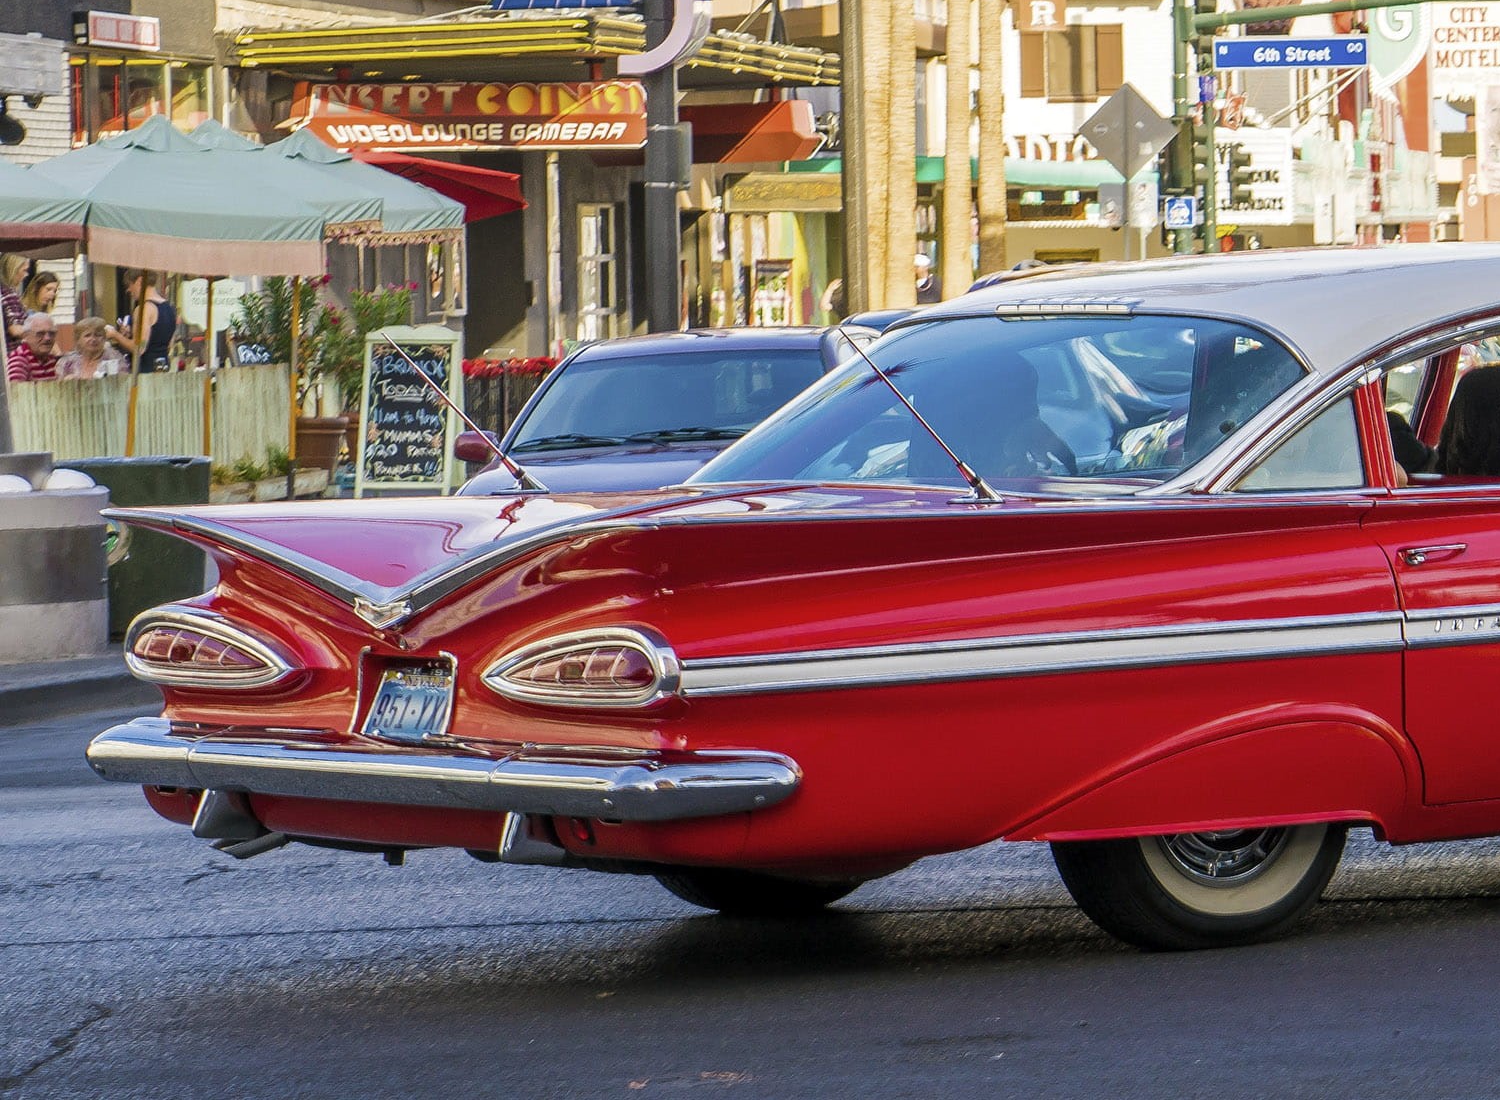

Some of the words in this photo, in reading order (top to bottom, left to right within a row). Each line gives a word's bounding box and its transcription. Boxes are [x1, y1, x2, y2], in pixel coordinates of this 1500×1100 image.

[1449, 6, 1488, 24] CITY
[1253, 46, 1281, 63] 6th
[1285, 46, 1332, 63] Street
[327, 122, 504, 144] VIDEOLOUNGE
[509, 121, 628, 143] GAMEBAR
